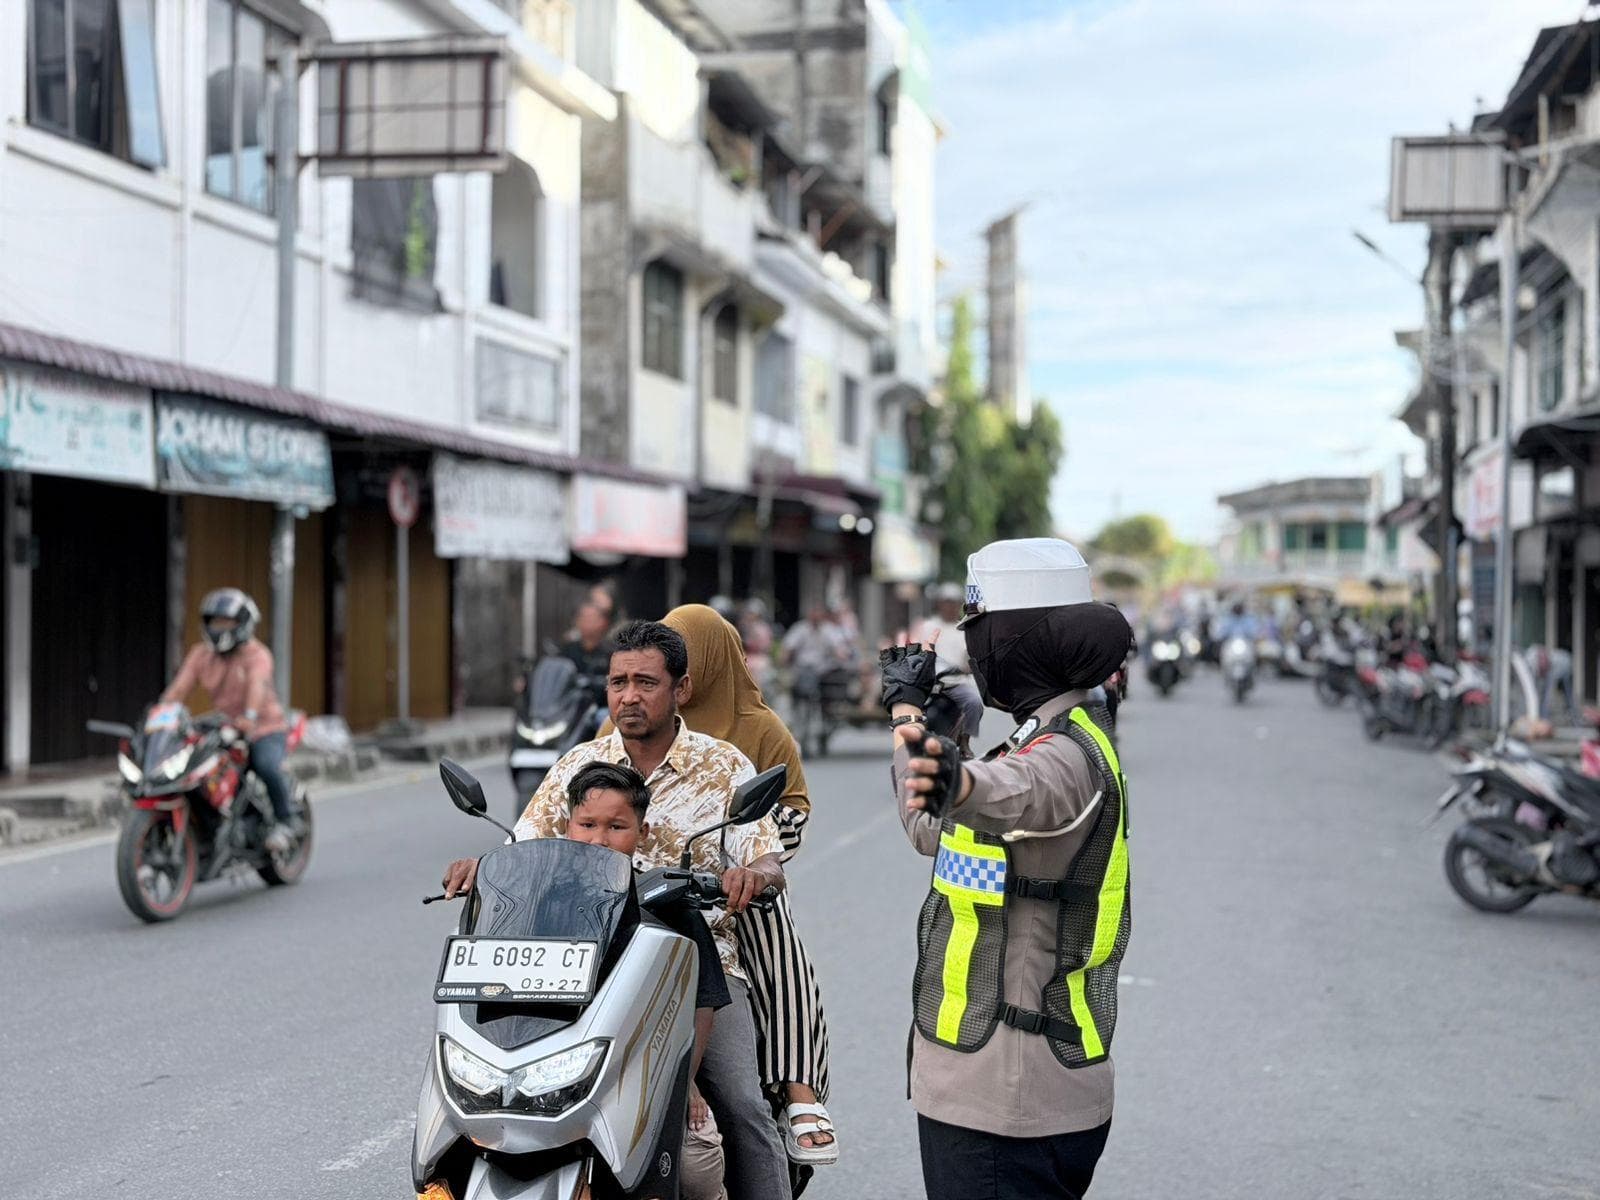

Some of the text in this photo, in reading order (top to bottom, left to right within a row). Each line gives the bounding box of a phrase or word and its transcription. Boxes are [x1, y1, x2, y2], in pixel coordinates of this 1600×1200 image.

[454, 945, 590, 969] BL 6092 CT
[447, 987, 476, 997] YAMAHA
[651, 999, 678, 1051] YAMAHA
